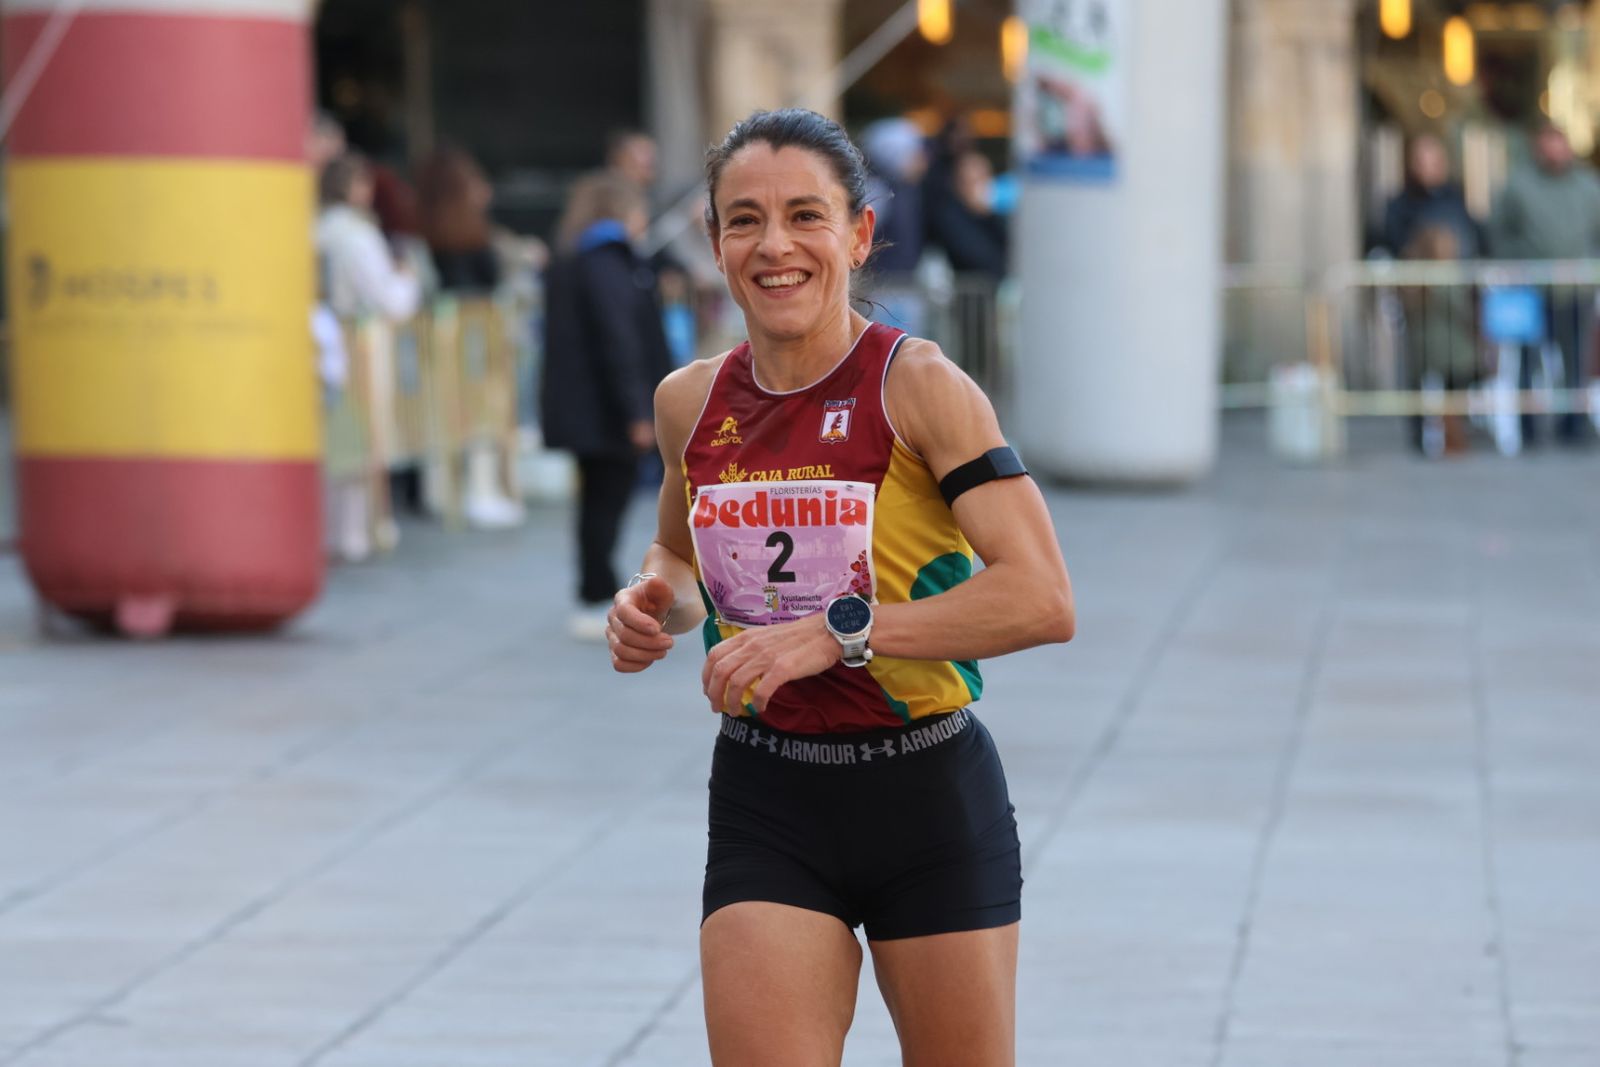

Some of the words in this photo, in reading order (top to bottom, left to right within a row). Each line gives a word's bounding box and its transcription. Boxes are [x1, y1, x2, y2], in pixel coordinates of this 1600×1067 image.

[749, 469, 783, 482] CAJA
[786, 464, 835, 480] RURAL
[770, 484, 822, 495] FLORISTERÍAS
[693, 489, 868, 529] bedunia
[765, 531, 797, 583] 2
[781, 594, 822, 603] Ayuntamiento
[782, 603, 789, 611] de
[791, 603, 823, 611] Salamanca
[780, 738, 857, 765] ARMOUR
[900, 710, 968, 754] ARMOUR
